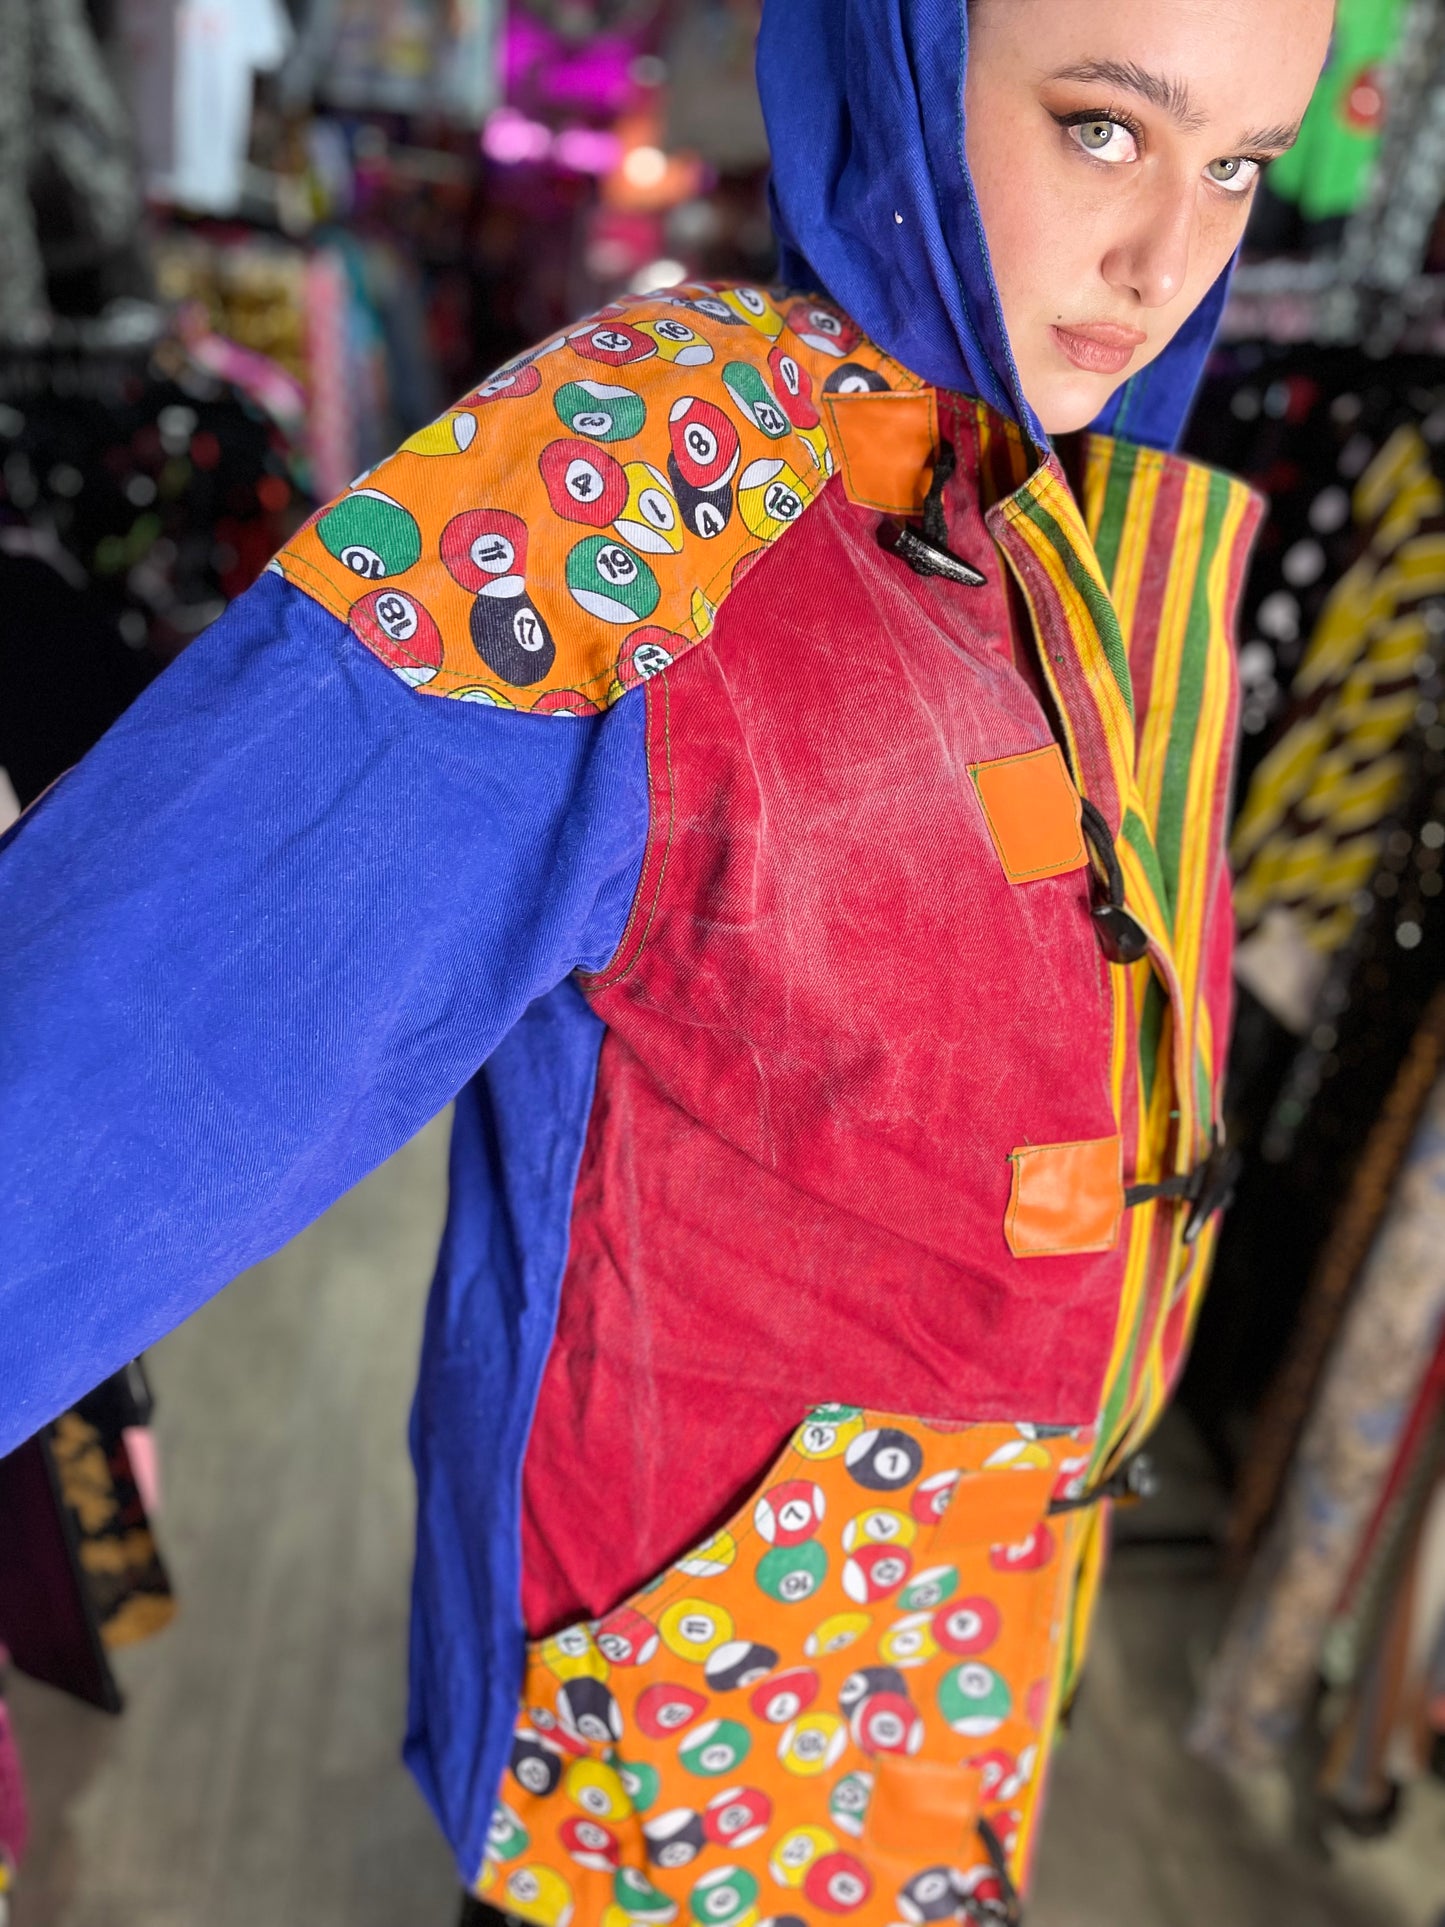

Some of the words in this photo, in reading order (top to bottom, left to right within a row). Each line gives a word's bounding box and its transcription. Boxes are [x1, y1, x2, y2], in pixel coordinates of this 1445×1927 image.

[658, 321, 689, 340] 16
[756, 407, 784, 431] 12
[687, 429, 711, 457] 8
[570, 472, 592, 498] 4
[646, 497, 668, 523] 1
[767, 485, 800, 517] 18
[702, 509, 720, 536] 4
[477, 540, 508, 562] 11
[597, 548, 634, 580] 19
[379, 596, 412, 637] 18
[515, 615, 537, 646] 17
[809, 1426, 832, 1448] 2
[784, 1505, 805, 1522] 7
